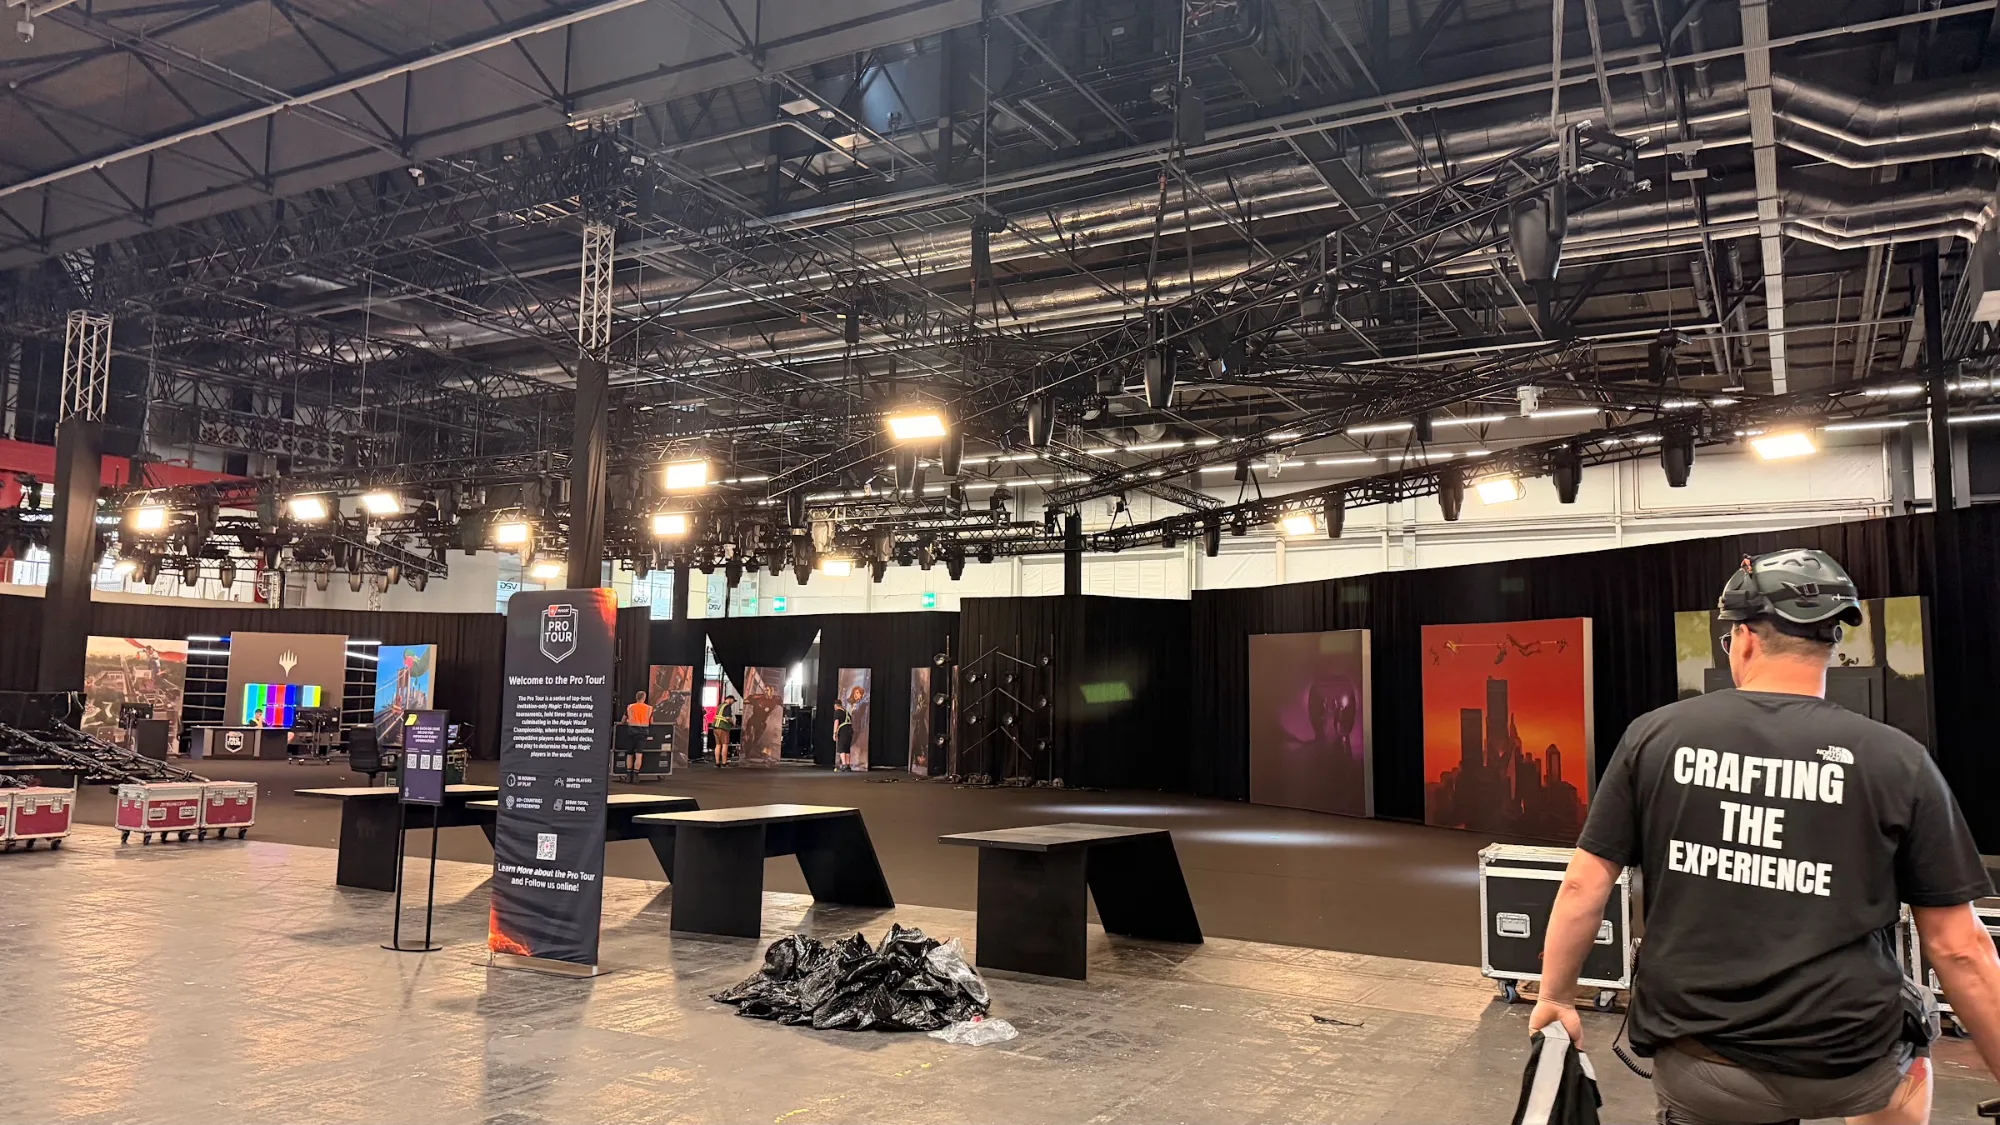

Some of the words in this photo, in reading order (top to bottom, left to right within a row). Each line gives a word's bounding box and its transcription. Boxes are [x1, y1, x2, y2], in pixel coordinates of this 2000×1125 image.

[548, 620, 569, 632] PRO
[544, 631, 573, 643] TOUR
[508, 675, 544, 686] Welcome
[545, 675, 554, 685] to
[555, 675, 568, 685] the
[569, 675, 584, 685] Pro
[585, 675, 606, 685] Tour!
[1673, 746, 1845, 805] CRAFTING
[1720, 800, 1785, 850] THE
[498, 863, 516, 873] Learn
[516, 865, 533, 875] More
[534, 867, 553, 877] about
[555, 869, 566, 878] the
[567, 870, 579, 880] Pro
[580, 872, 595, 881] Tour
[1668, 839, 1833, 897] EXPERIENCE
[511, 877, 523, 886] and
[524, 878, 546, 888] Follow
[547, 881, 556, 890] us
[556, 882, 579, 892] online!
